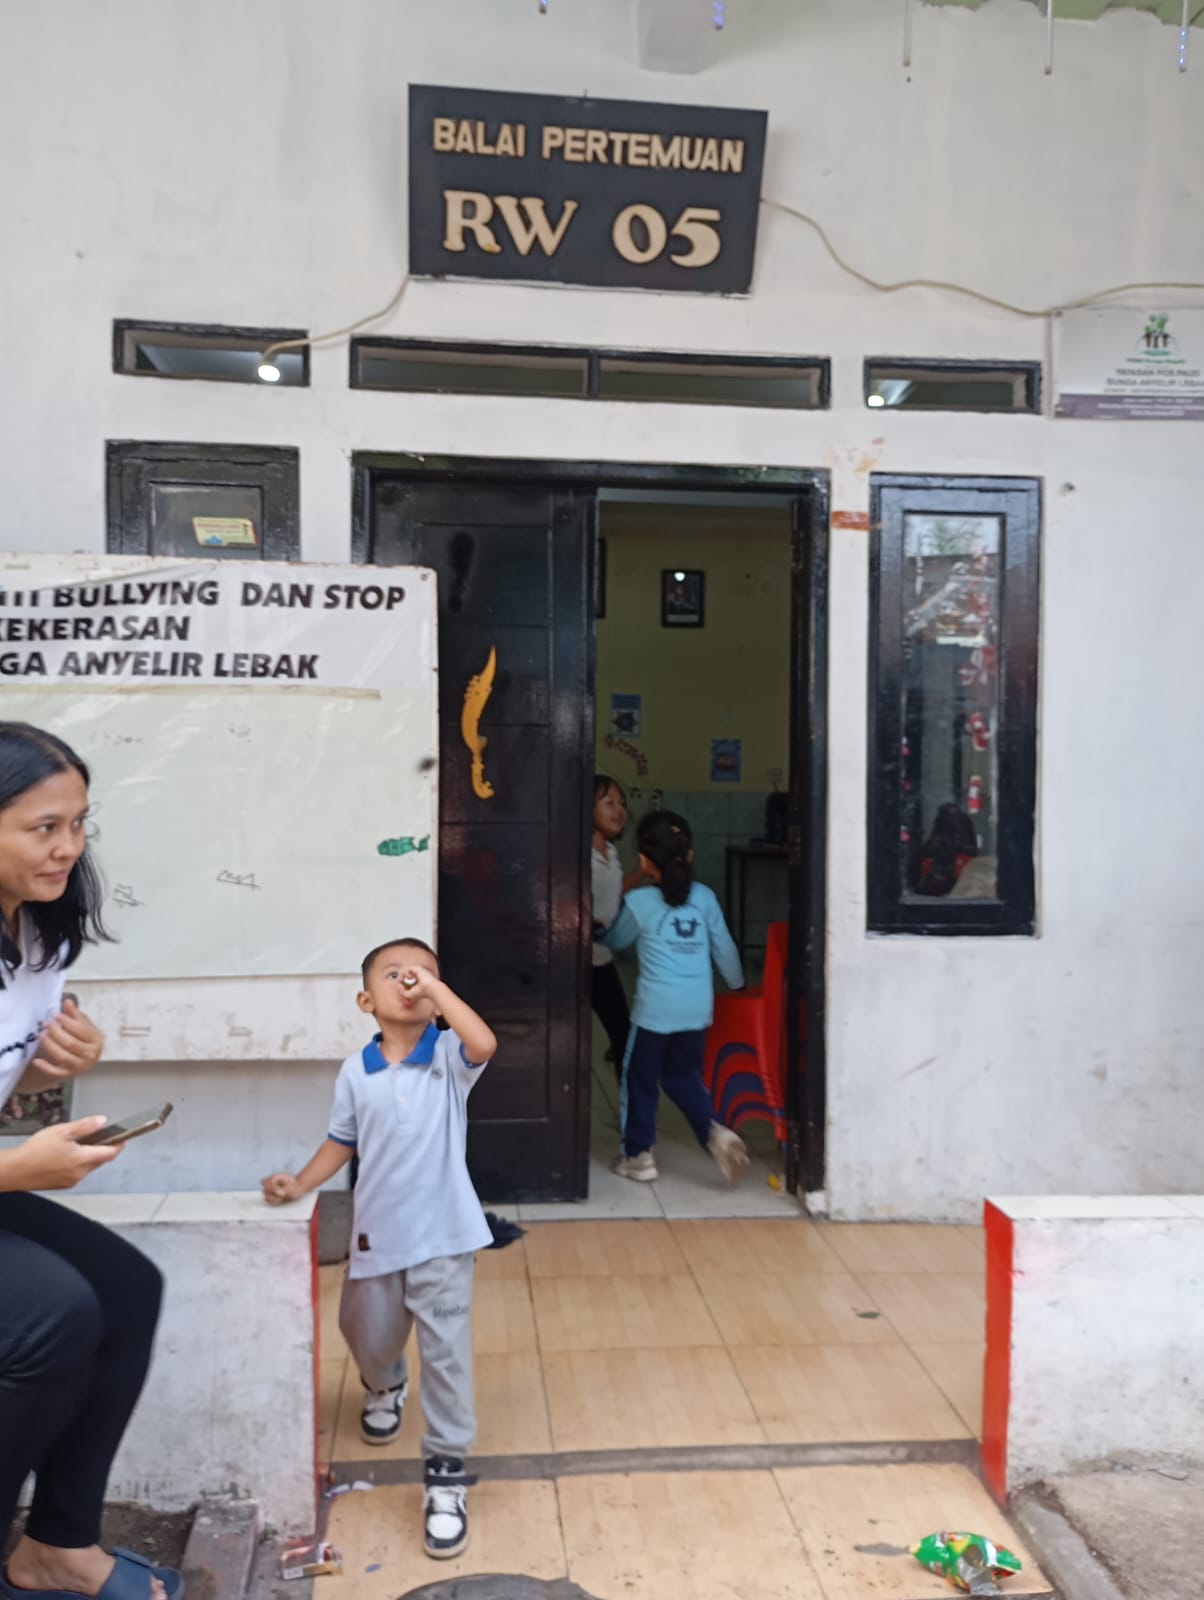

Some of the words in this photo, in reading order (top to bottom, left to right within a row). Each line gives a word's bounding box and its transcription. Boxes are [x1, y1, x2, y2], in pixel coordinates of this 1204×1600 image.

[433, 117, 526, 158] BALAI
[542, 125, 745, 173] PERTEMUAN
[442, 189, 578, 256] RW
[612, 203, 722, 268] 05
[53, 580, 219, 608] BULLYING
[240, 582, 314, 608] DAN
[323, 584, 406, 610] STOP
[0, 615, 191, 641] EKERASAN
[0, 651, 47, 676] GA
[58, 650, 203, 677] ANYELIR
[213, 652, 319, 679] LEBAK
